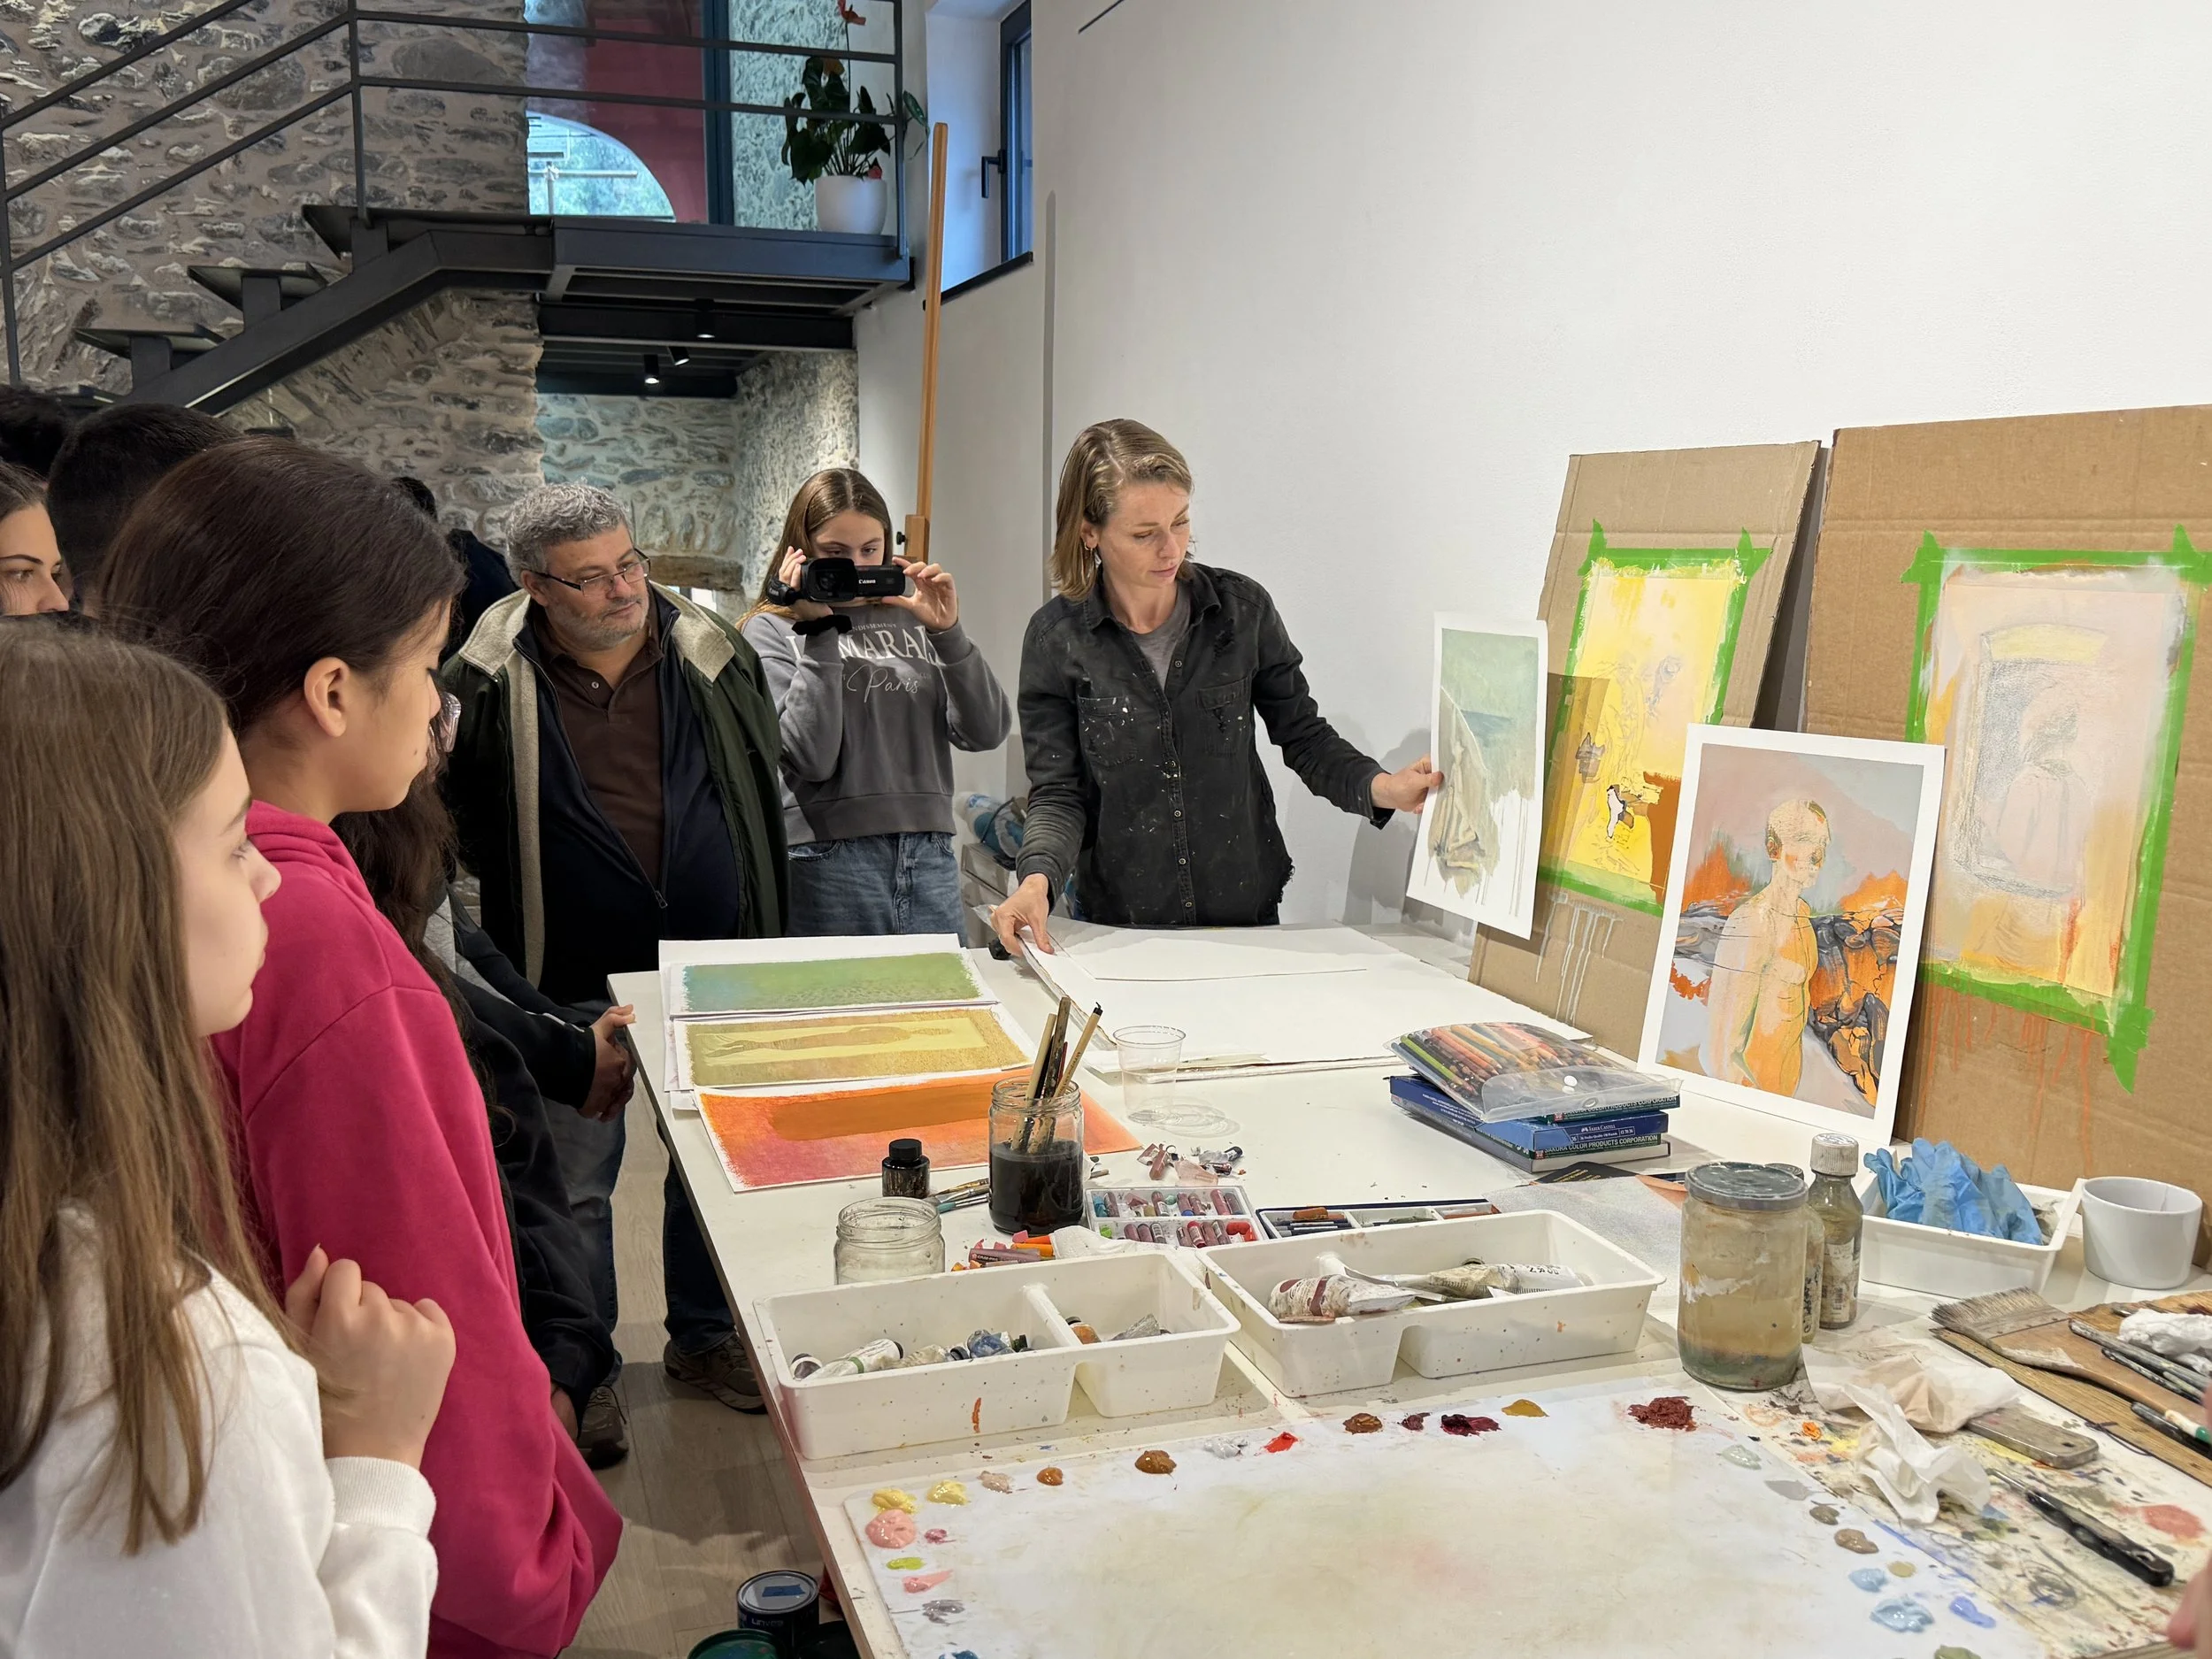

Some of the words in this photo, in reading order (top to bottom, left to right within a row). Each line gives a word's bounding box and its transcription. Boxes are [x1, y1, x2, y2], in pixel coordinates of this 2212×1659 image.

[846, 664, 919, 703] Paris
[1588, 1138, 1618, 1148] PRODUCTS
[1619, 1135, 1657, 1145] CORPORATION
